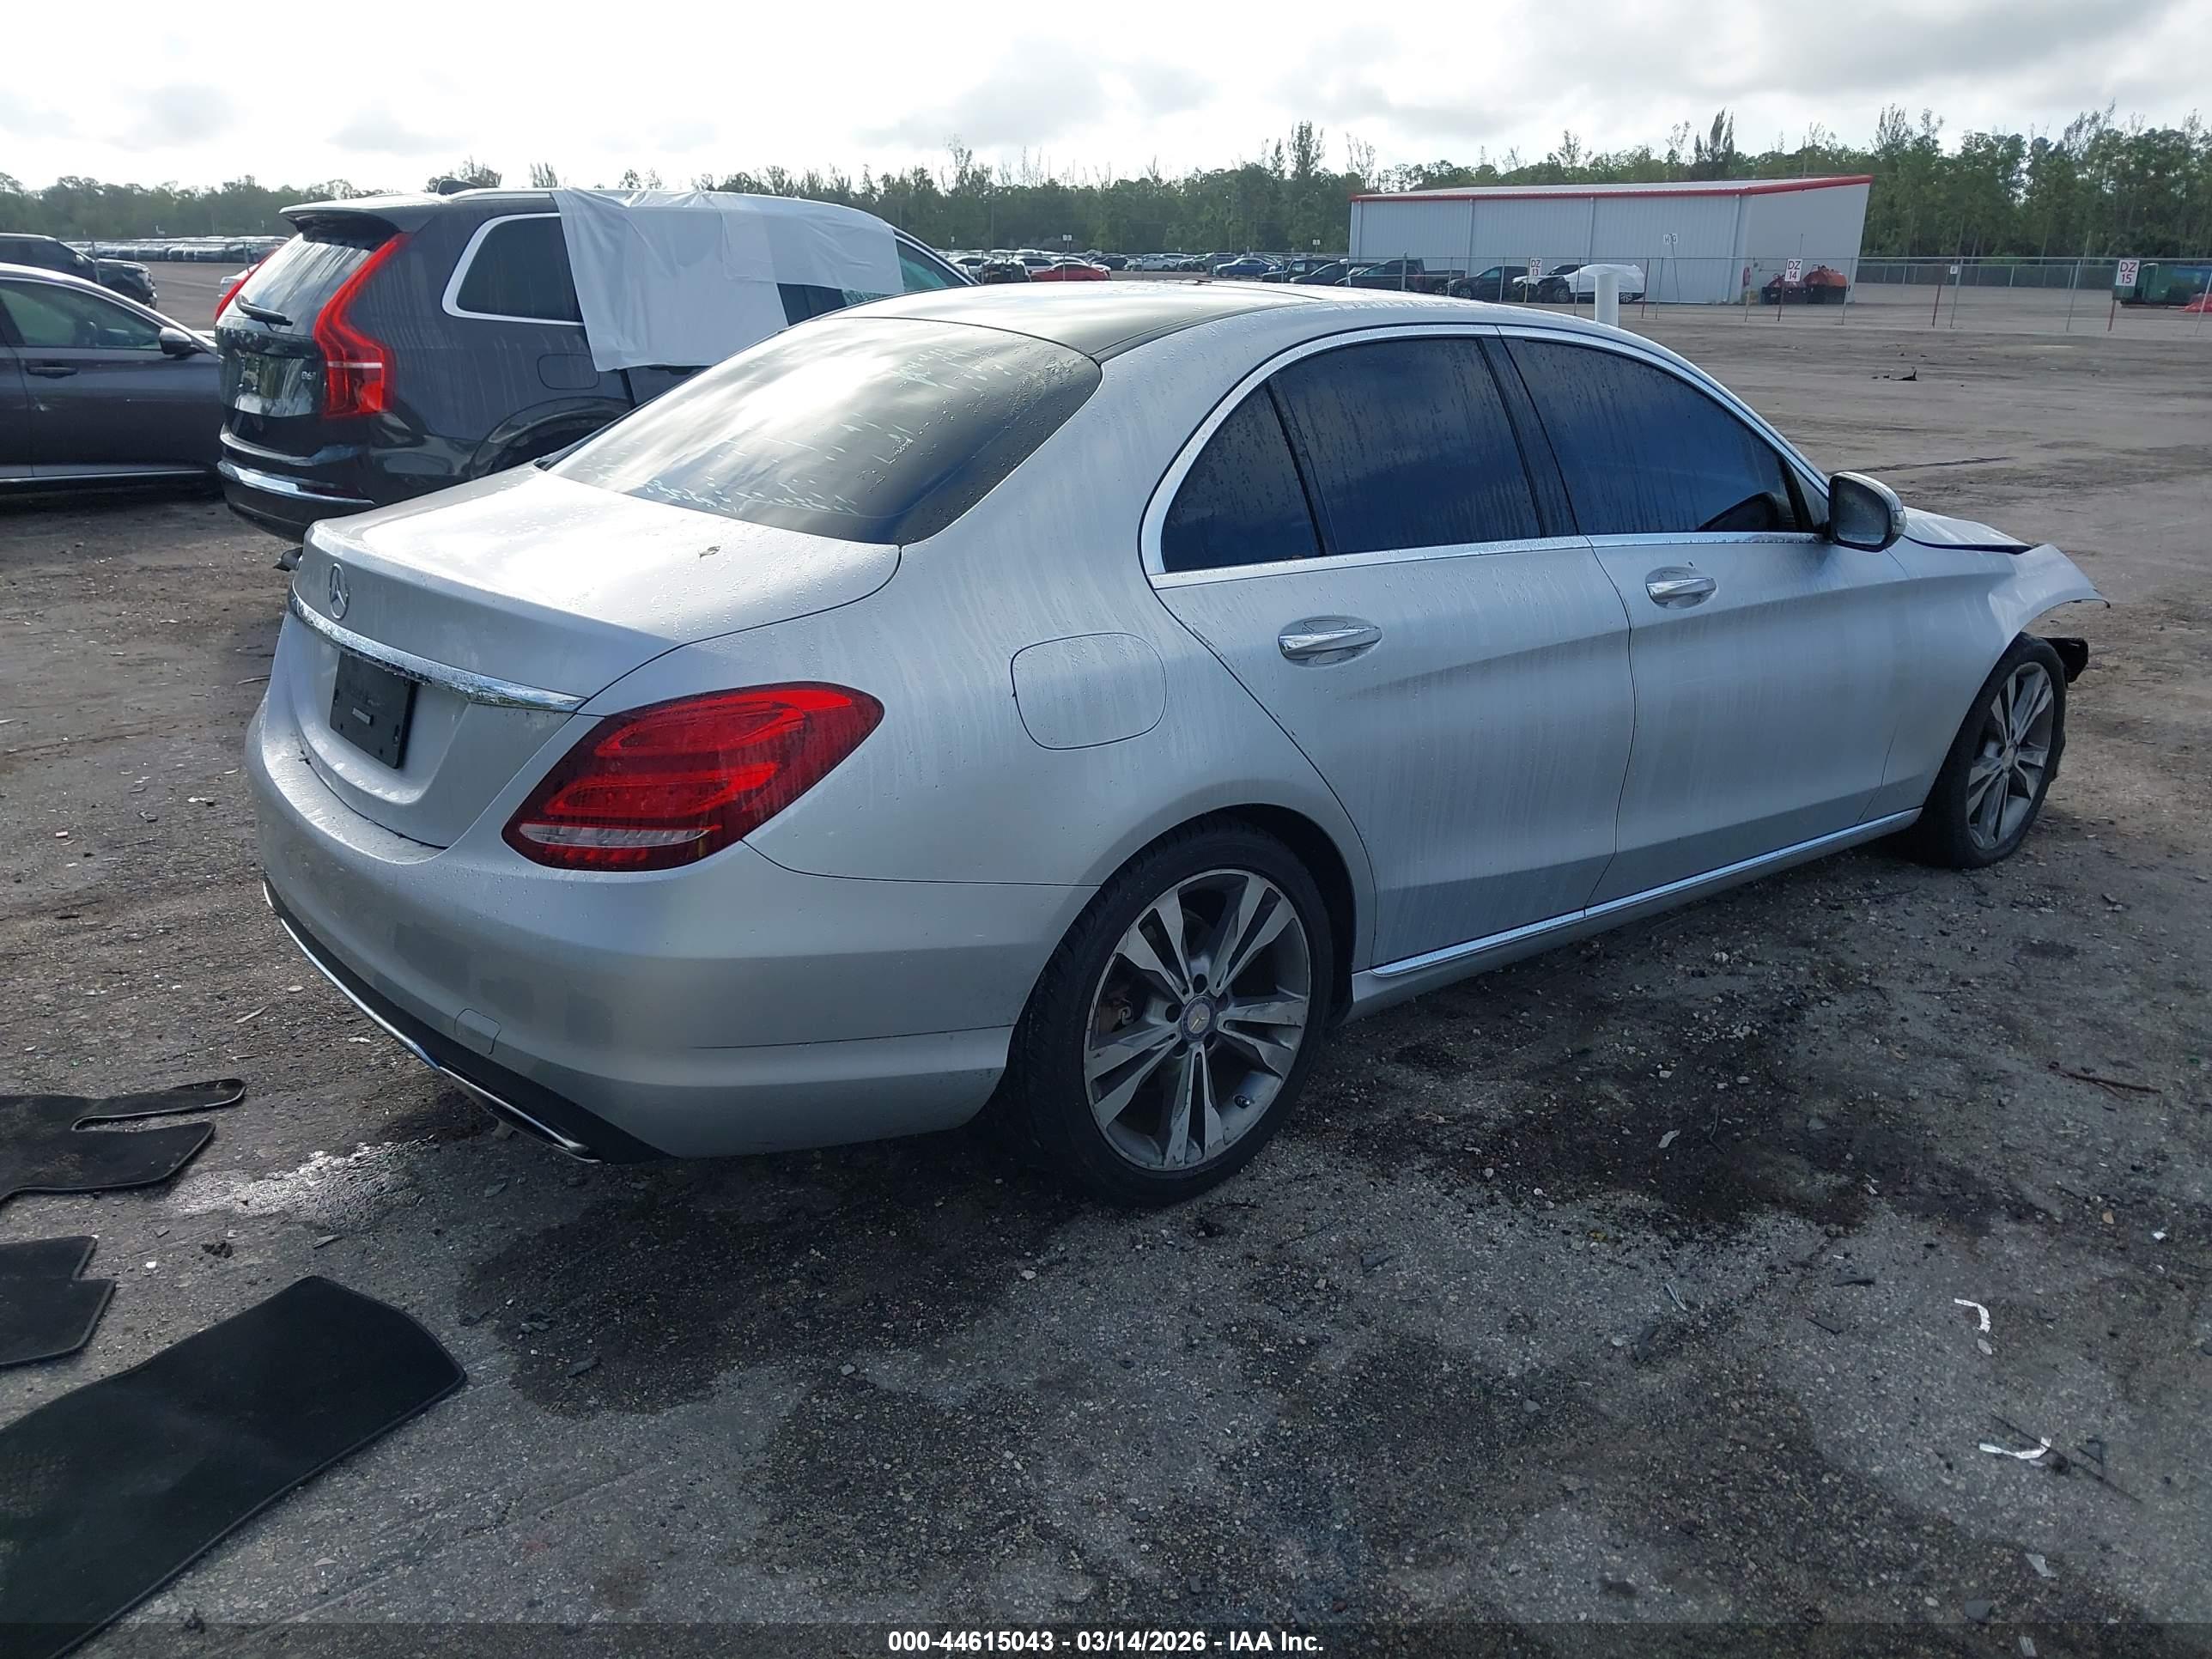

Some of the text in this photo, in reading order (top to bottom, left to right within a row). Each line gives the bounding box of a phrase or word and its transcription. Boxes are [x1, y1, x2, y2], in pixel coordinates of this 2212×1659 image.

[1788, 260, 1801, 270] DZ
[2120, 262, 2137, 272] DZ
[1532, 268, 1539, 276] 13
[1789, 270, 1797, 280] 14
[2122, 274, 2132, 283] 15
